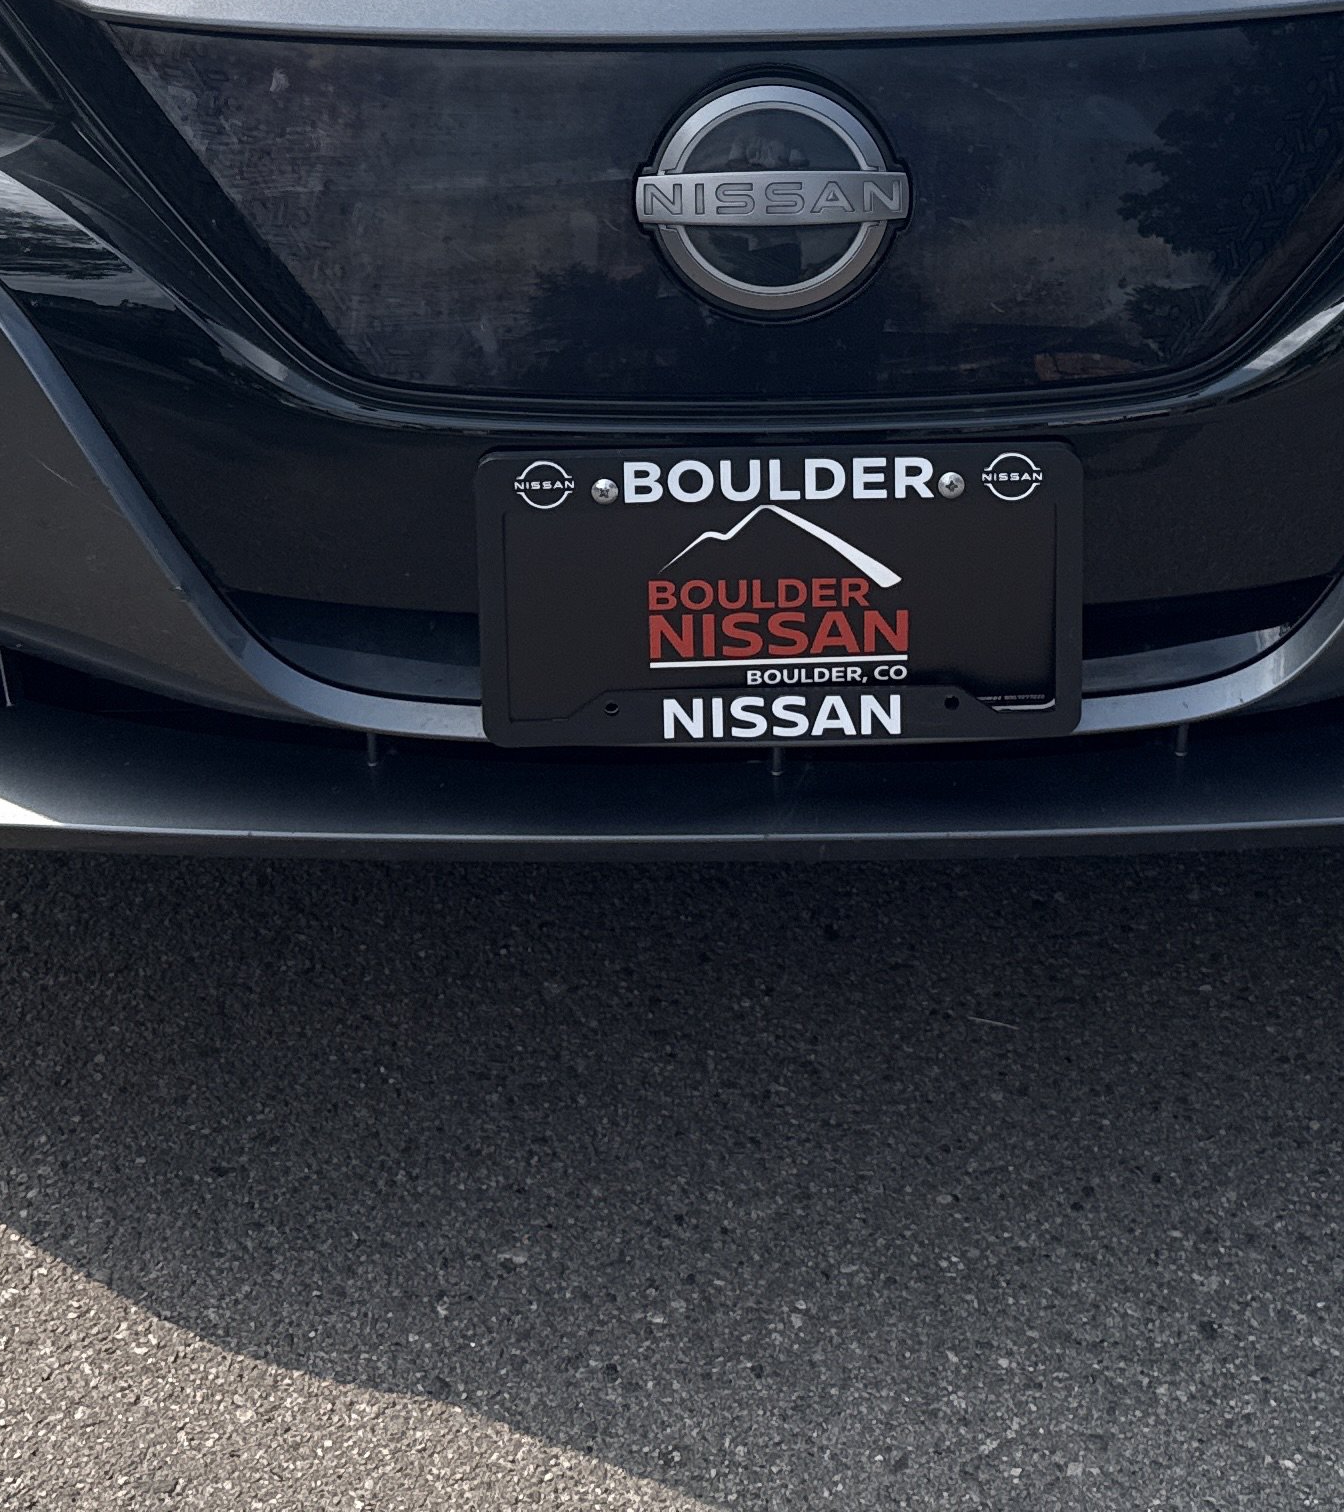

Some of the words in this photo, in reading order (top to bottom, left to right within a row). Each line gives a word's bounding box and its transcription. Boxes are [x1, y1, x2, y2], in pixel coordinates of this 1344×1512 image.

[643, 180, 902, 216] NISSAN
[514, 480, 575, 490] NISSAN
[623, 456, 935, 503] BOULDER
[981, 472, 1043, 482] NISSAN
[648, 577, 871, 611] BOULDER
[648, 609, 910, 659] NISSAN
[746, 666, 869, 685] BOULDER,
[873, 664, 908, 680] CO
[662, 694, 902, 739] NISSAN
